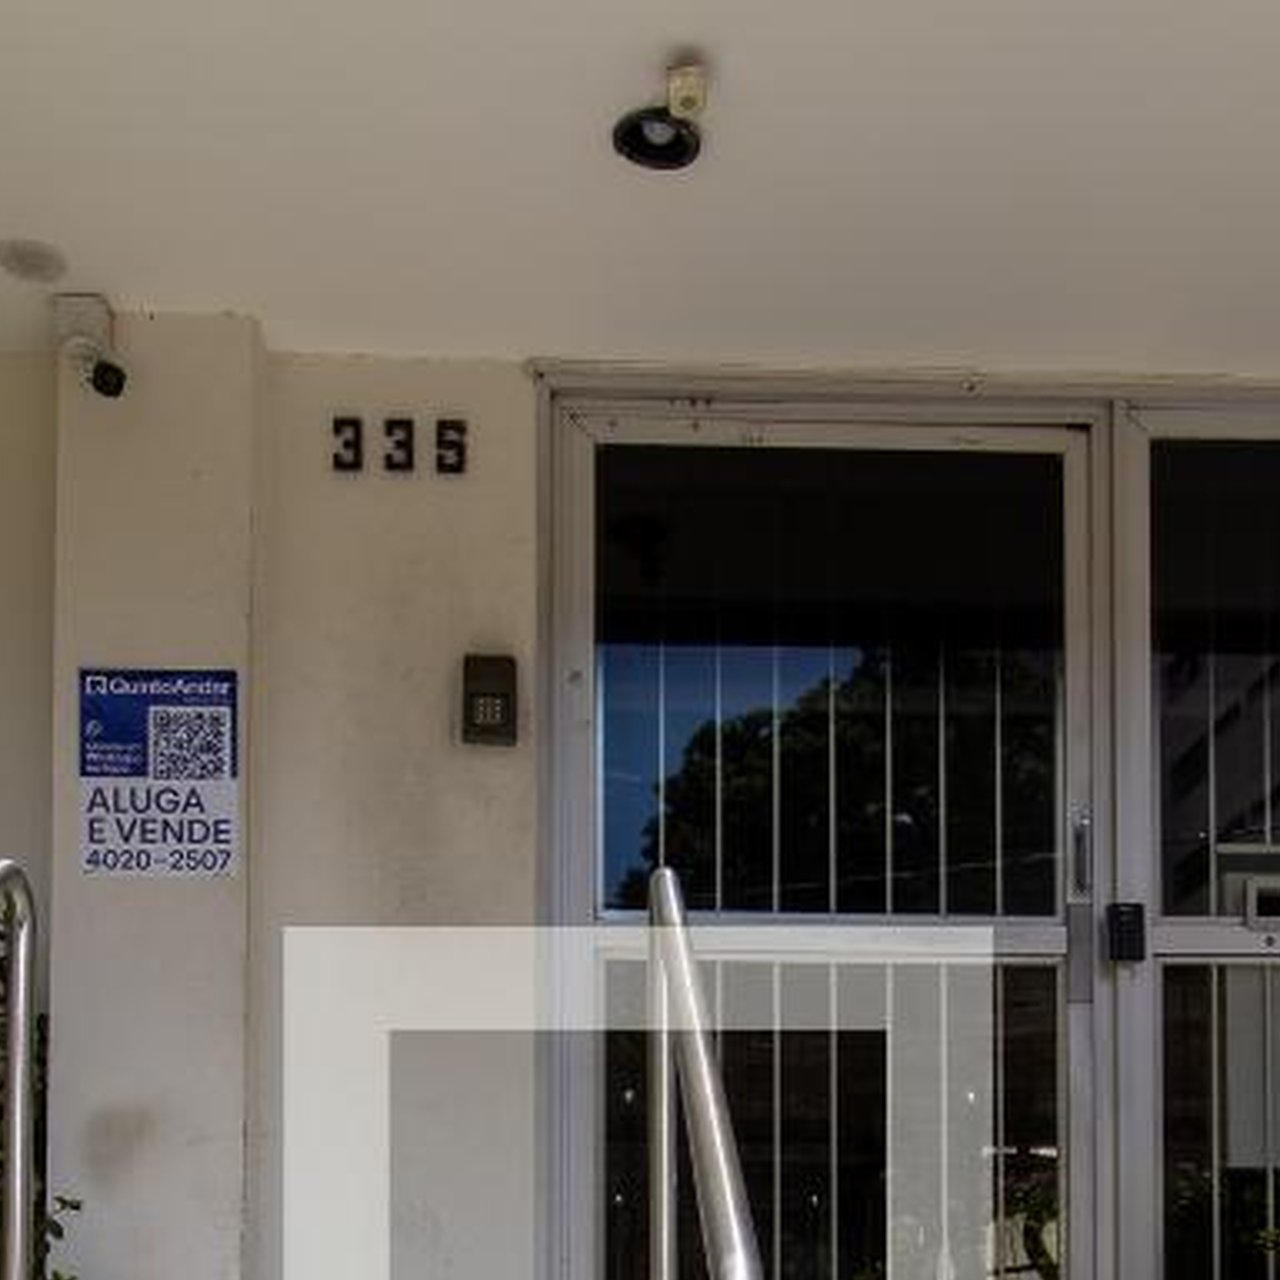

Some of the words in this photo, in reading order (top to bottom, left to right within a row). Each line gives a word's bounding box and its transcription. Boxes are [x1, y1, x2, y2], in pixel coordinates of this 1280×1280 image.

[332, 417, 467, 473] 335
[86, 786, 206, 815] ALUGA
[88, 818, 107, 844] E
[116, 818, 232, 845] VENDE
[85, 849, 232, 871] 4020-2507
